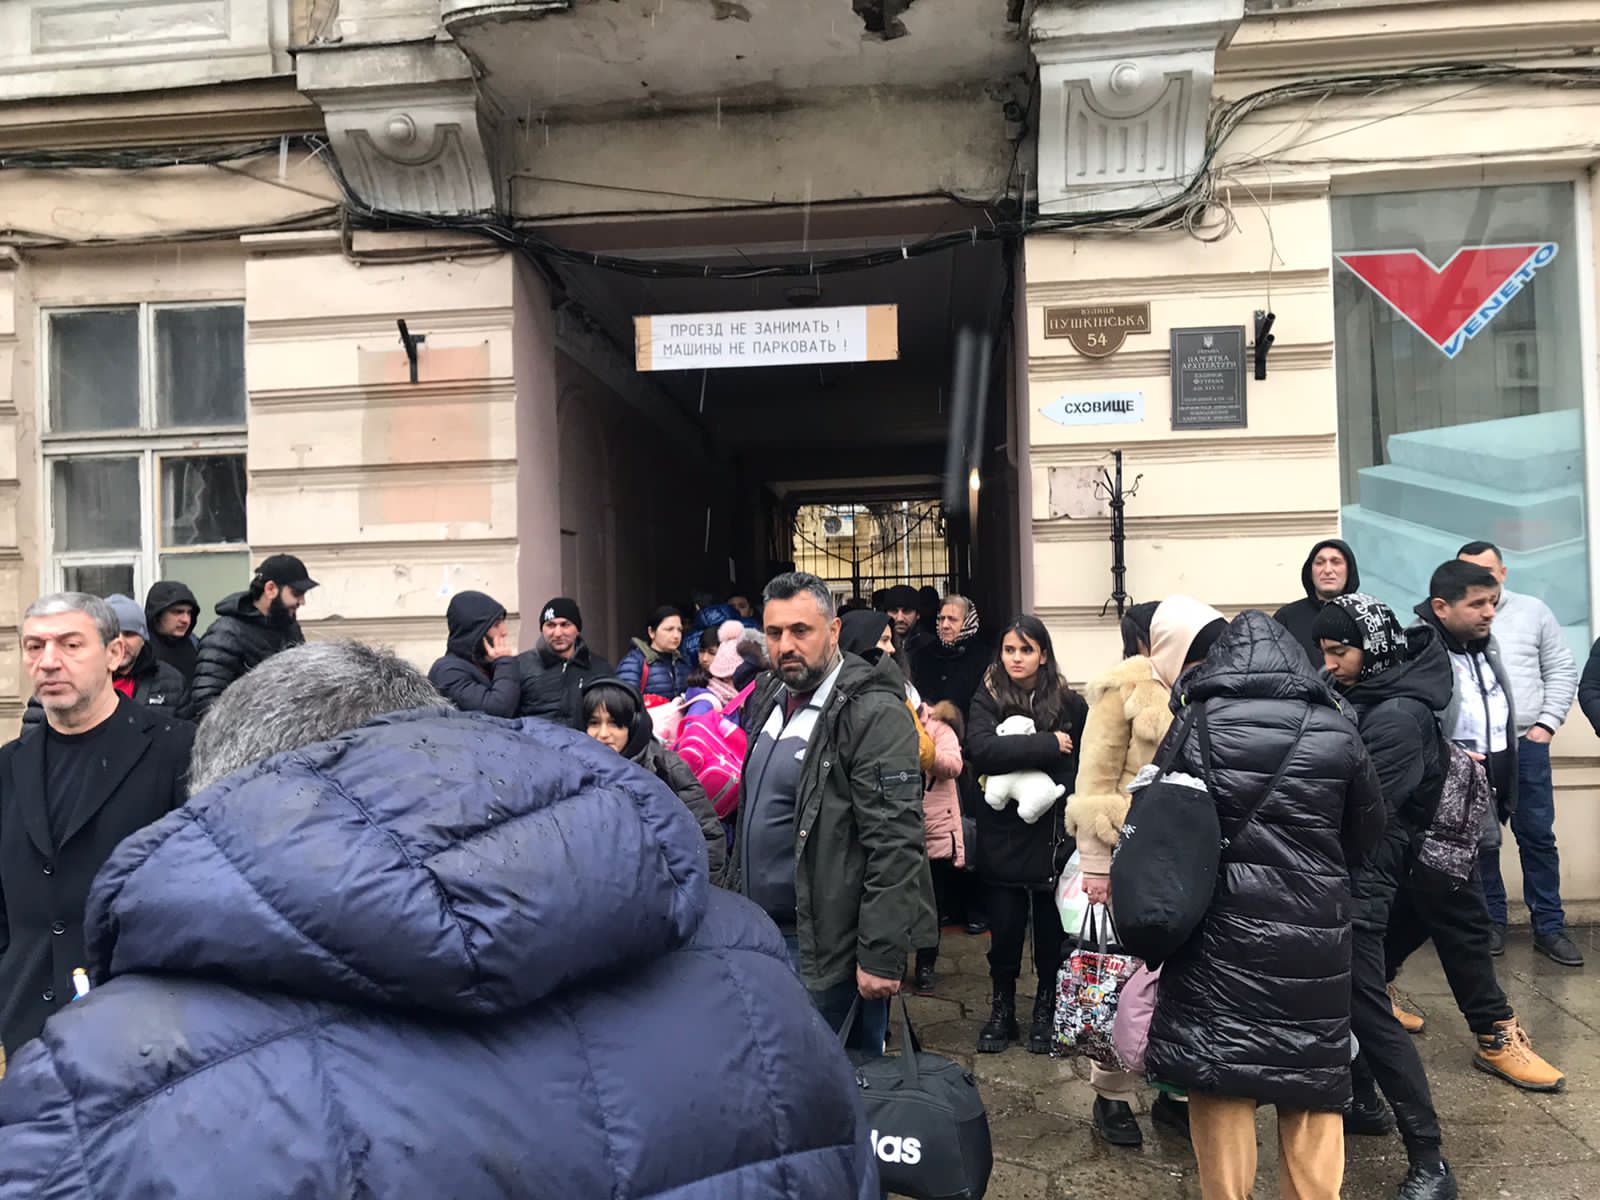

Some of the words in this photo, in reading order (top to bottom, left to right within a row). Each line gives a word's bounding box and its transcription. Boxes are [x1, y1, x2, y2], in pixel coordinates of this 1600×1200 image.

[1443, 244, 1554, 355] VENETO
[670, 322, 724, 337] ПРОЕЗД
[730, 322, 747, 335] НЕ
[754, 320, 830, 335] ЗАНИМАТЬ
[1049, 315, 1145, 330] ПУШКІНСЬКА
[663, 343, 722, 356] МАШИНЫ
[729, 342, 745, 355] НЕ
[752, 339, 837, 354] ПАРКОВАТЬ
[1087, 333, 1108, 347] 54
[1064, 400, 1135, 414] СХОВИЩЕ
